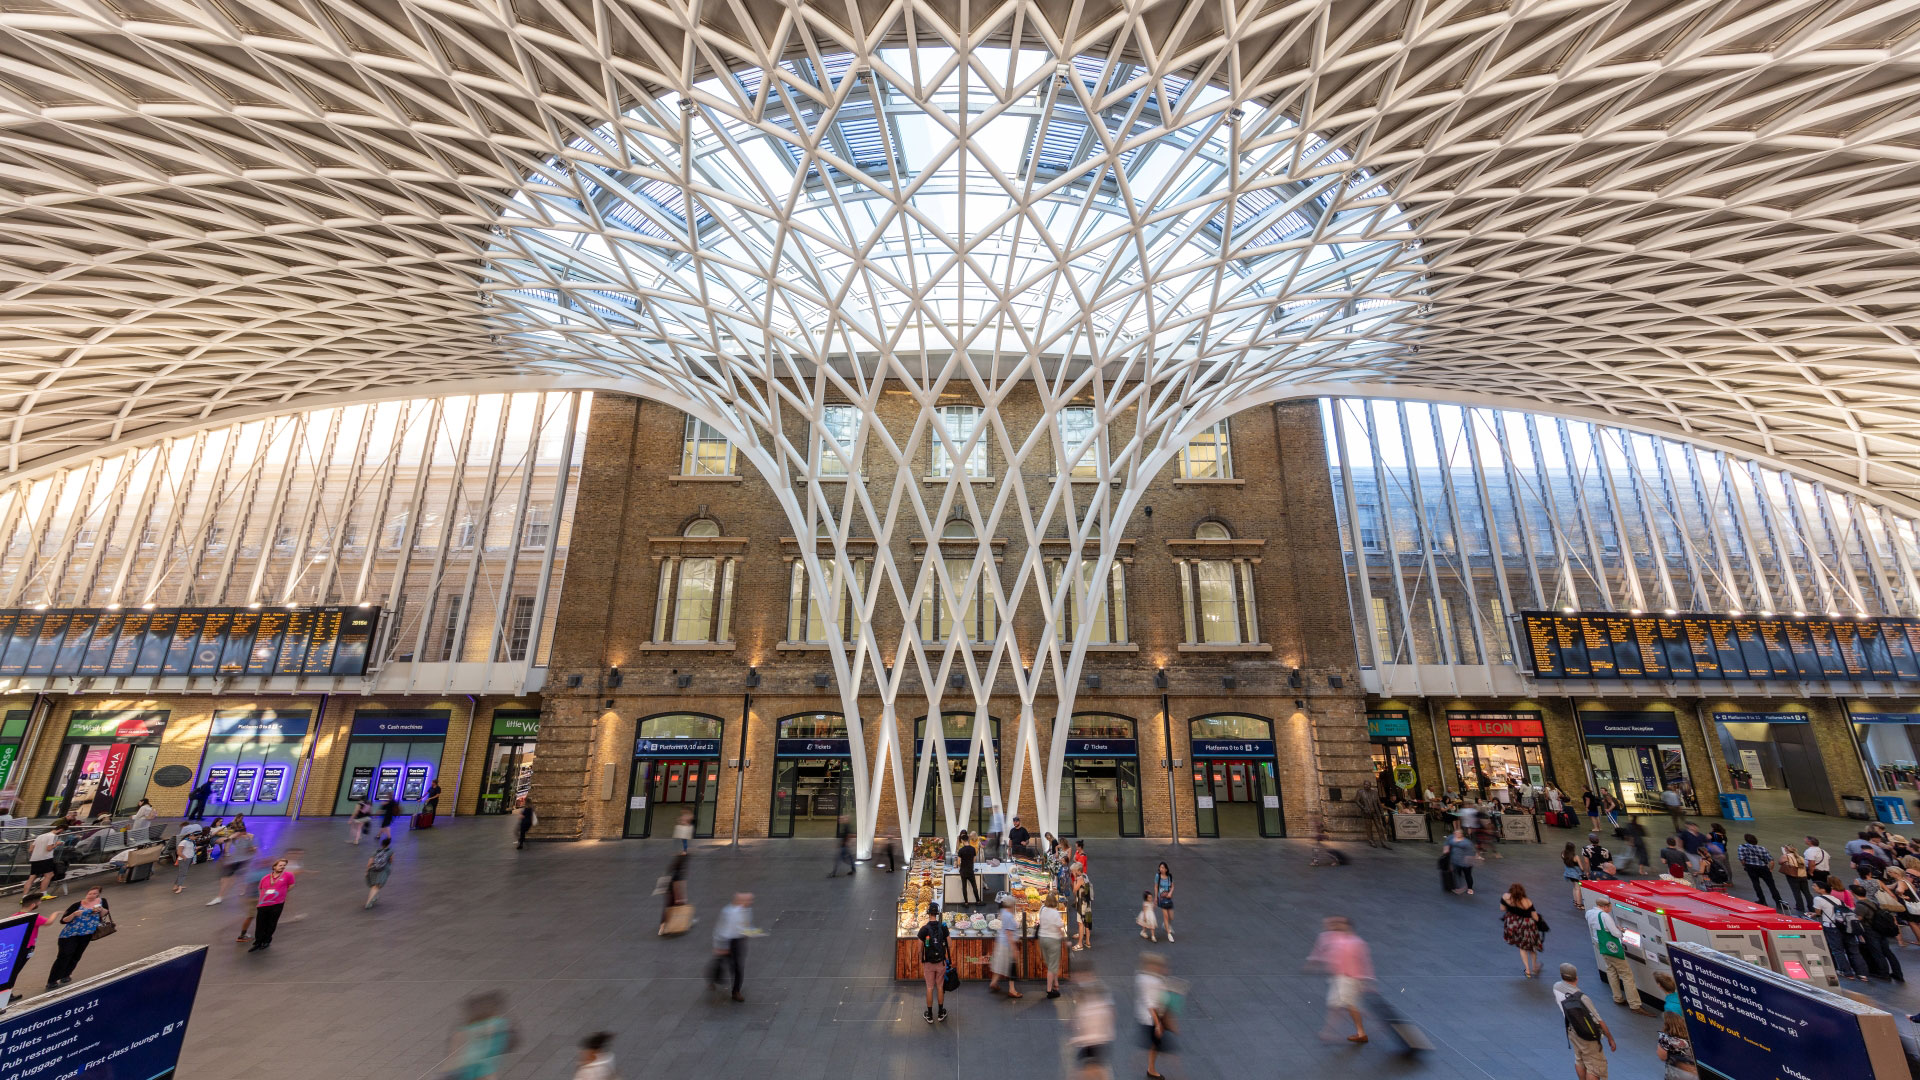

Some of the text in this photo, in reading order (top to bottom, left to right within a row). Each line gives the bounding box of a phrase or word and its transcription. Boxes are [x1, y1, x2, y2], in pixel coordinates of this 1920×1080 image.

[1479, 722, 1513, 735] LEON
[659, 743, 683, 751] Platforms
[100, 751, 121, 796] AZUMA
[1625, 898, 1639, 906] Tickets
[1694, 964, 1757, 995] Platforms 0 to 8
[1698, 977, 1763, 1011] Dining & seating
[11, 998, 99, 1039] Platforms 9 to 11
[1701, 990, 1768, 1026] Dining & seating
[1704, 1004, 1725, 1018] Taxis
[46, 1027, 70, 1039] Babycare
[1707, 1017, 1741, 1039] Way out
[1, 1035, 78, 1072] Pub restaurant
[7, 1036, 42, 1055] Toilets
[85, 1055, 106, 1071] First
[107, 1045, 130, 1060] class
[130, 1032, 160, 1050] lounge
[21, 1055, 63, 1078] luggage
